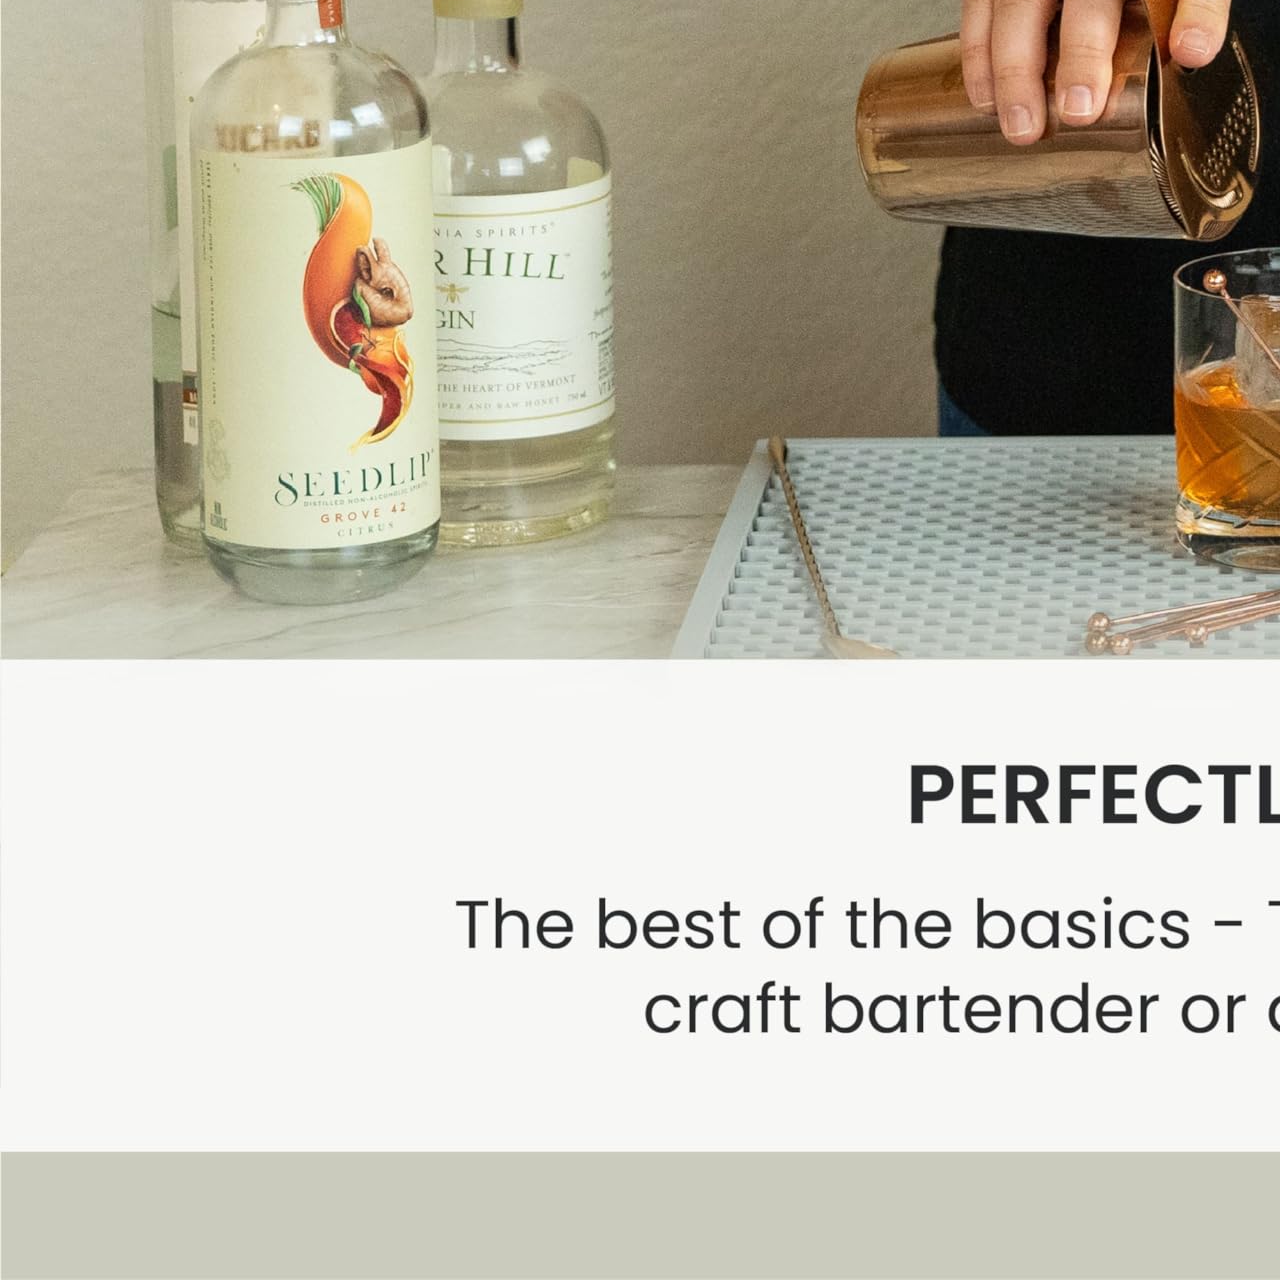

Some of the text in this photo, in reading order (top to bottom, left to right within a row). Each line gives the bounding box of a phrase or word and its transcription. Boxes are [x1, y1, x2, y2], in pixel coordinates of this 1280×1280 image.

[475, 224, 548, 238] SPIRITS
[462, 247, 565, 280] HILL
[435, 308, 476, 330] GIN
[437, 374, 577, 393] THE HEART OF VERMONT
[468, 402, 492, 410] AND
[274, 451, 431, 507] SEEDLIP
[303, 499, 345, 508] DISTILLED
[347, 488, 409, 505] NON-ALCOHOLIC
[320, 501, 407, 524] GROVE 42
[337, 521, 395, 538] CITRUS
